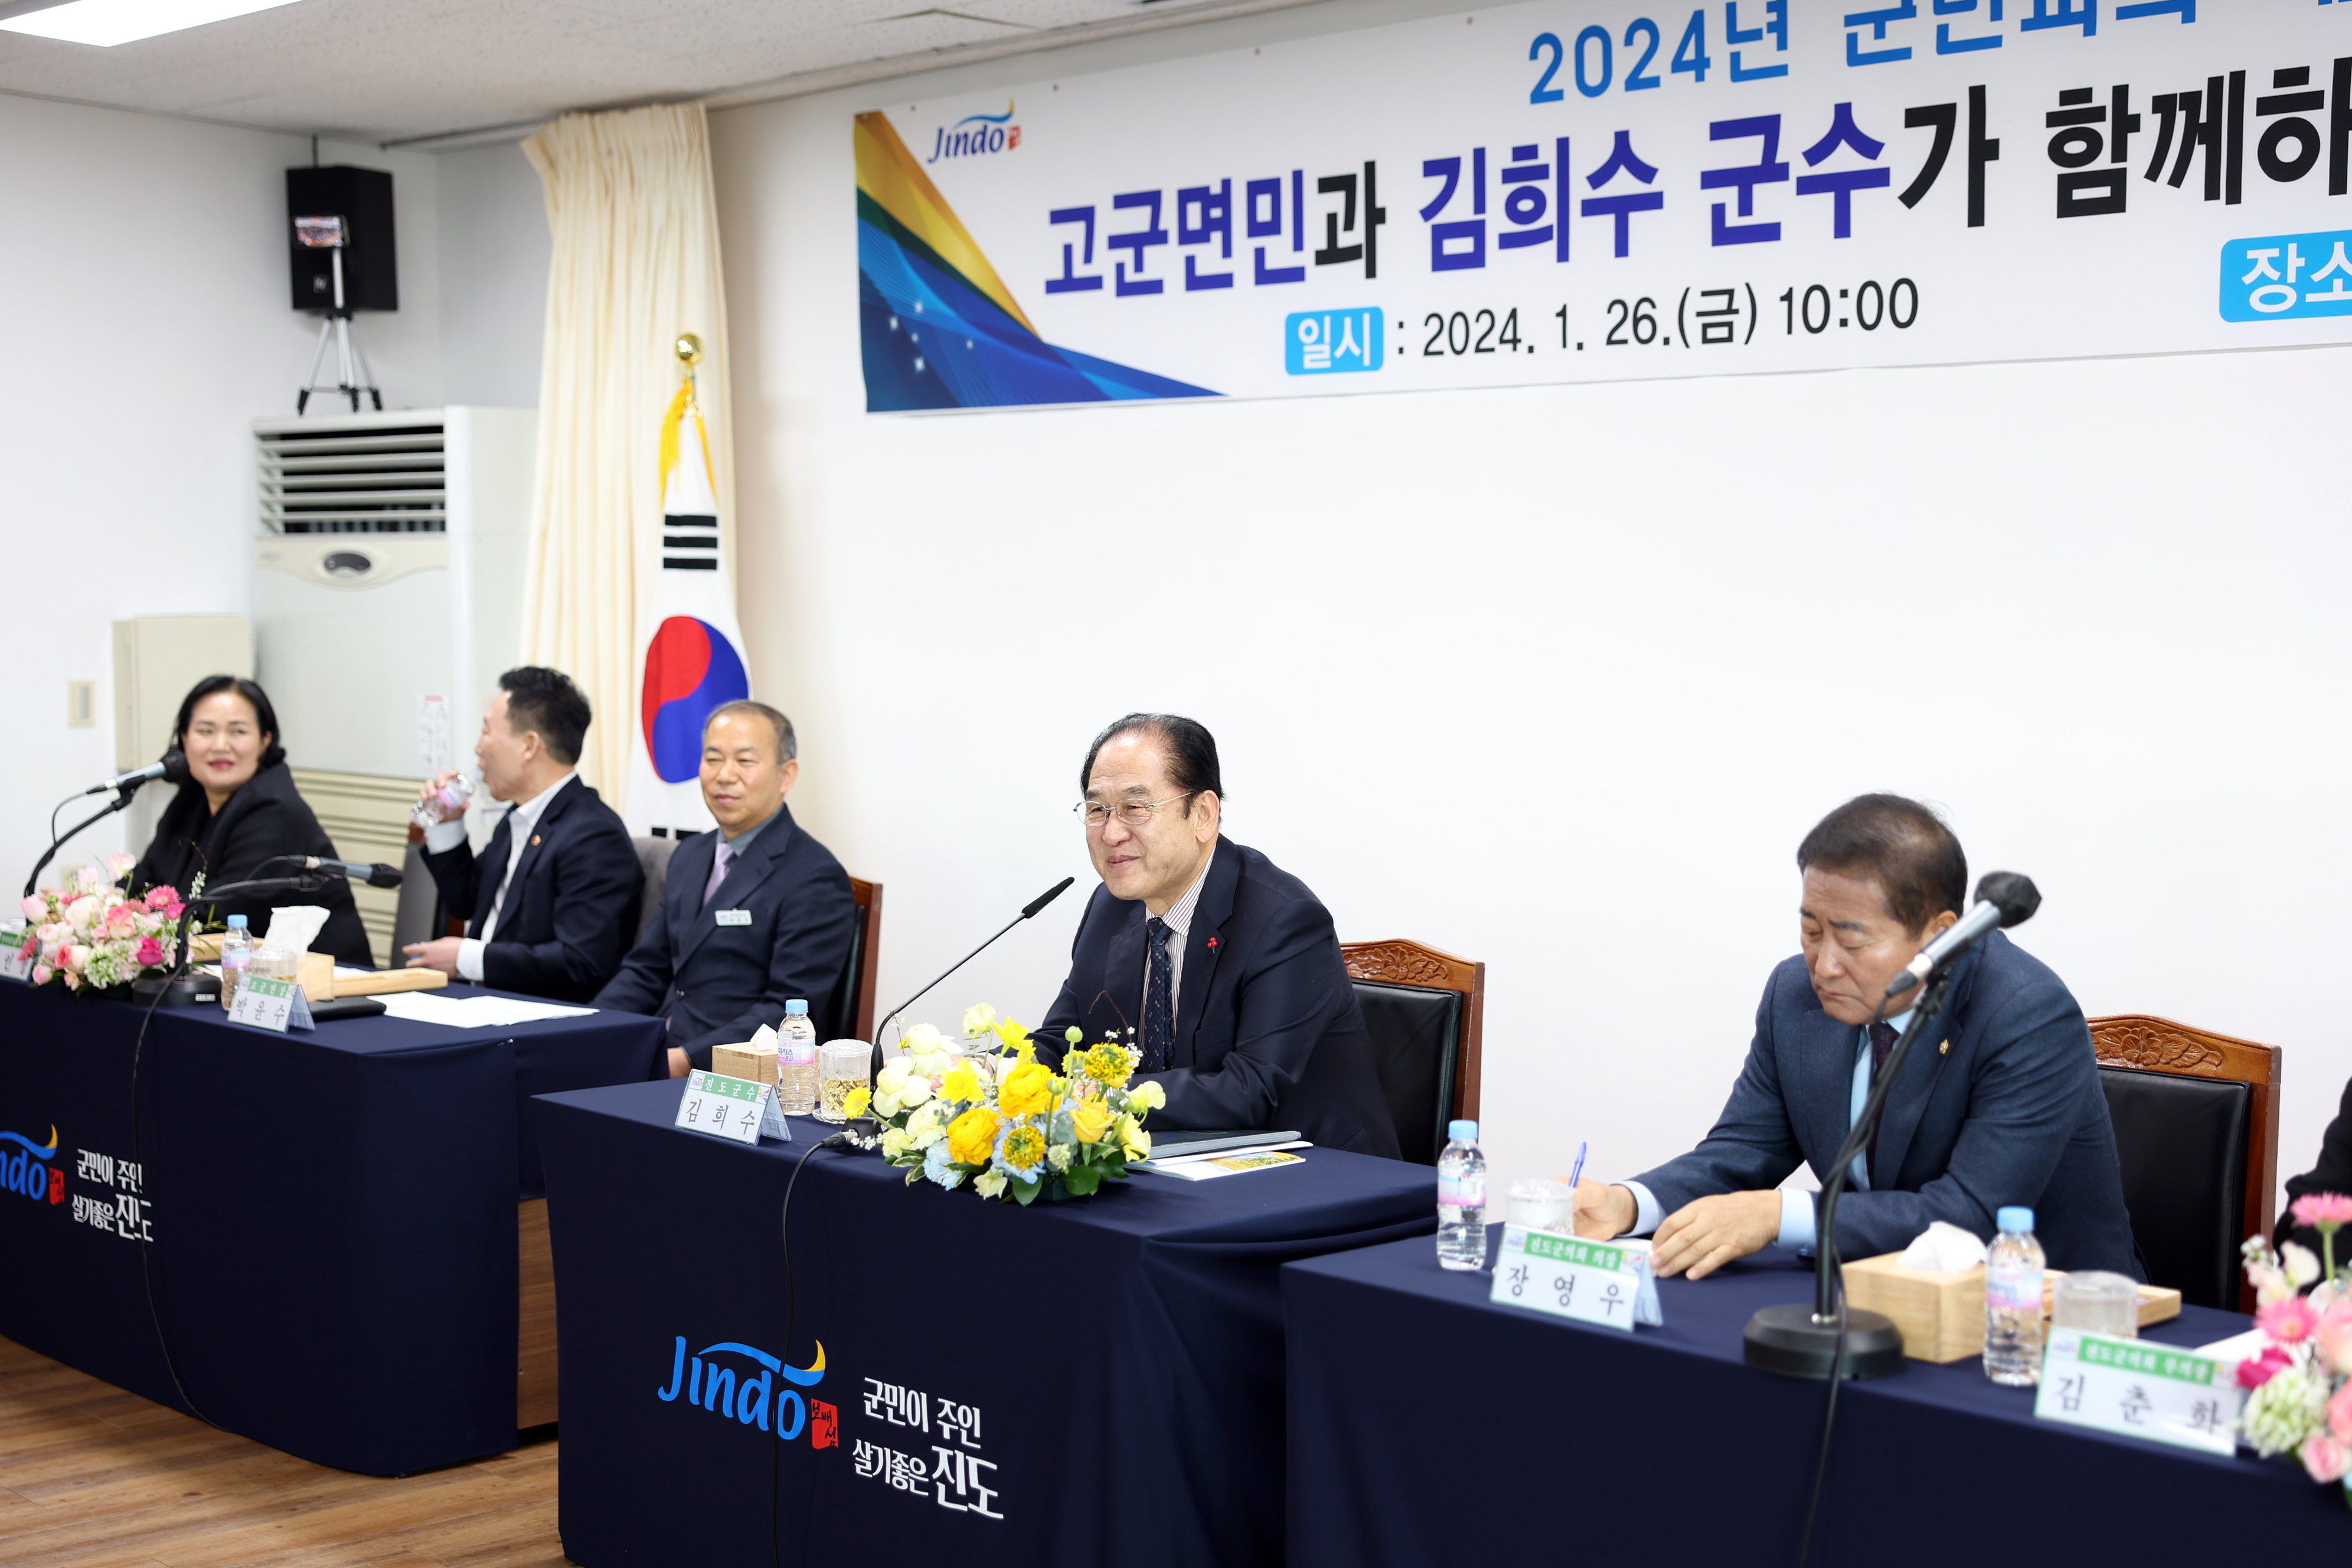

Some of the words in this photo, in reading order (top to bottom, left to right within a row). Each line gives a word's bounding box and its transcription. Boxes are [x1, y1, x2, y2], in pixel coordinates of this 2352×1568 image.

[1529, 0, 1789, 104] 2024년
[1844, 0, 2196, 67] 군민
[927, 123, 1004, 164] Jindo
[1044, 160, 1387, 298] 고군면민과
[1419, 129, 1664, 273] 김희수
[1700, 84, 2000, 247] 군수가
[2045, 55, 2352, 220] 함께하
[2241, 241, 2352, 313] 장소
[1298, 312, 1371, 370] 일시
[1423, 306, 1535, 357] 2024.
[1556, 303, 1585, 351] 1.
[1605, 282, 1758, 348] 26.(금)
[1779, 277, 1919, 335] 10:00
[685, 1098, 756, 1136] 김희수
[705, 1077, 755, 1100] 진도군수
[77, 1148, 114, 1187] 군민이
[117, 1159, 142, 1193] 주인
[71, 1194, 115, 1232] 살기좋은
[115, 1193, 153, 1242] 진도
[658, 1336, 806, 1440] Jindo
[863, 1377, 929, 1433] 군민이
[936, 1397, 981, 1449] 주인
[852, 1438, 929, 1496] 살기좋은
[931, 1445, 1004, 1519] 진도
